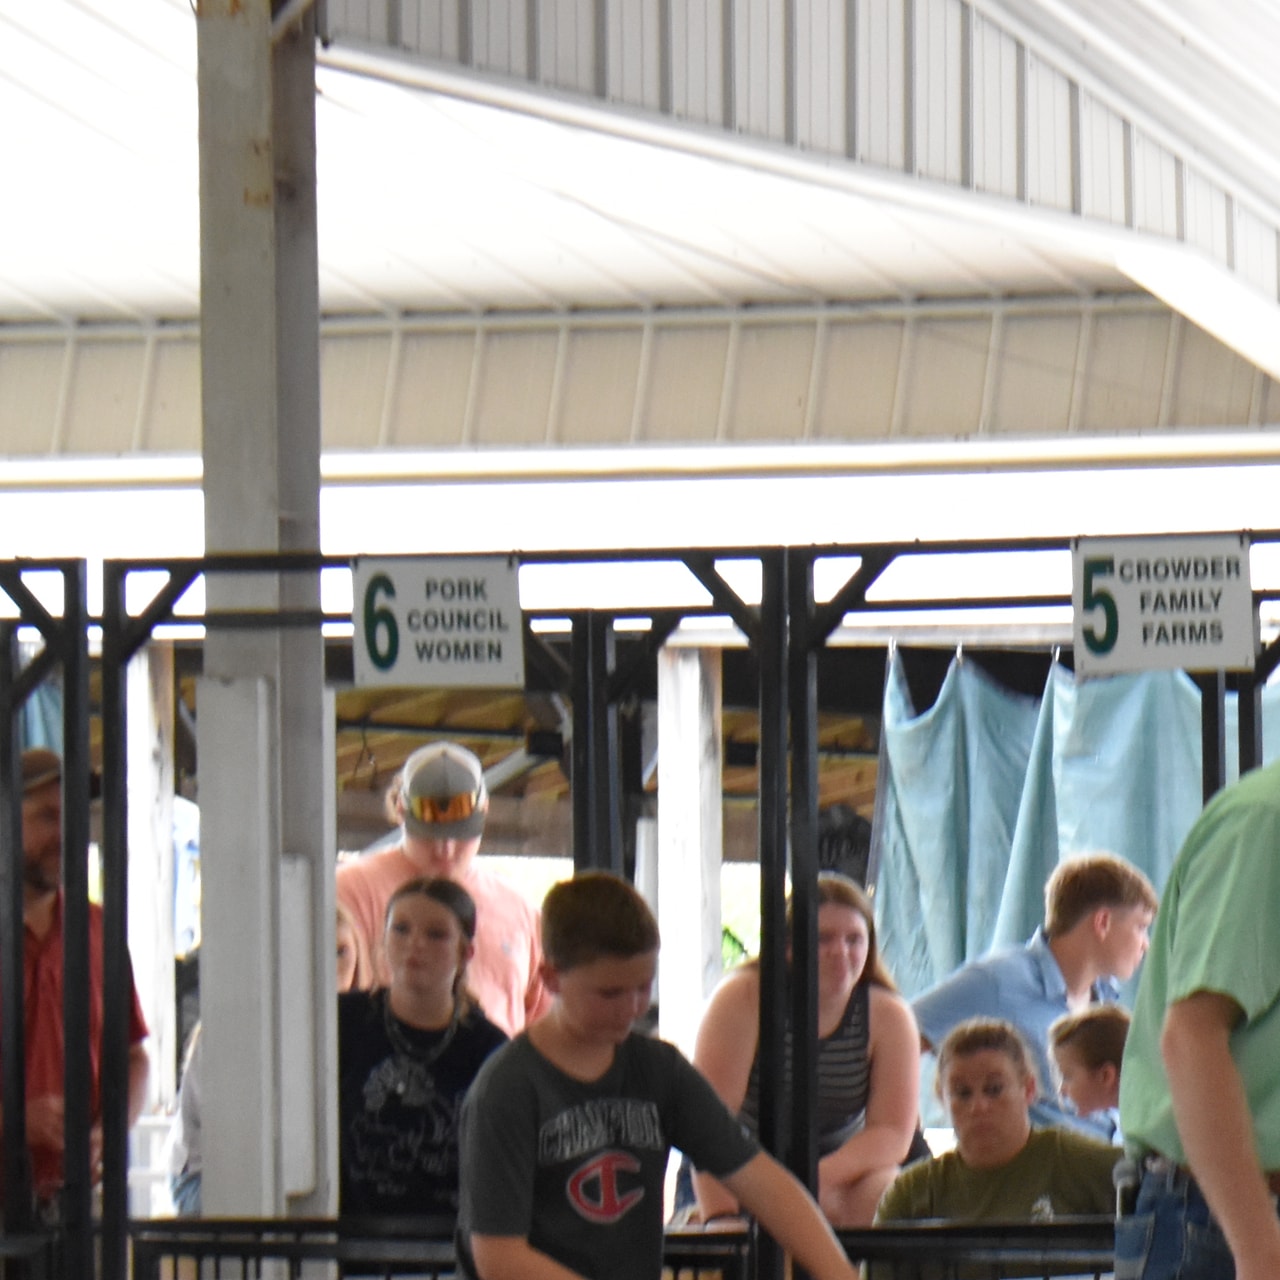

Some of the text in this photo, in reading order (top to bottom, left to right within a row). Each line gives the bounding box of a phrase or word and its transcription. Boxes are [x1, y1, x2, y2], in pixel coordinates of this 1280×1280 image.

[1119, 555, 1241, 583] CROWDER
[425, 578, 488, 602] PORK
[1140, 587, 1223, 615] FAMILY
[1082, 554, 1119, 657] 5
[364, 572, 399, 672] 6
[407, 608, 510, 633] COUNCIL
[1142, 619, 1224, 646] FARMS
[415, 640, 503, 663] WOMEN
